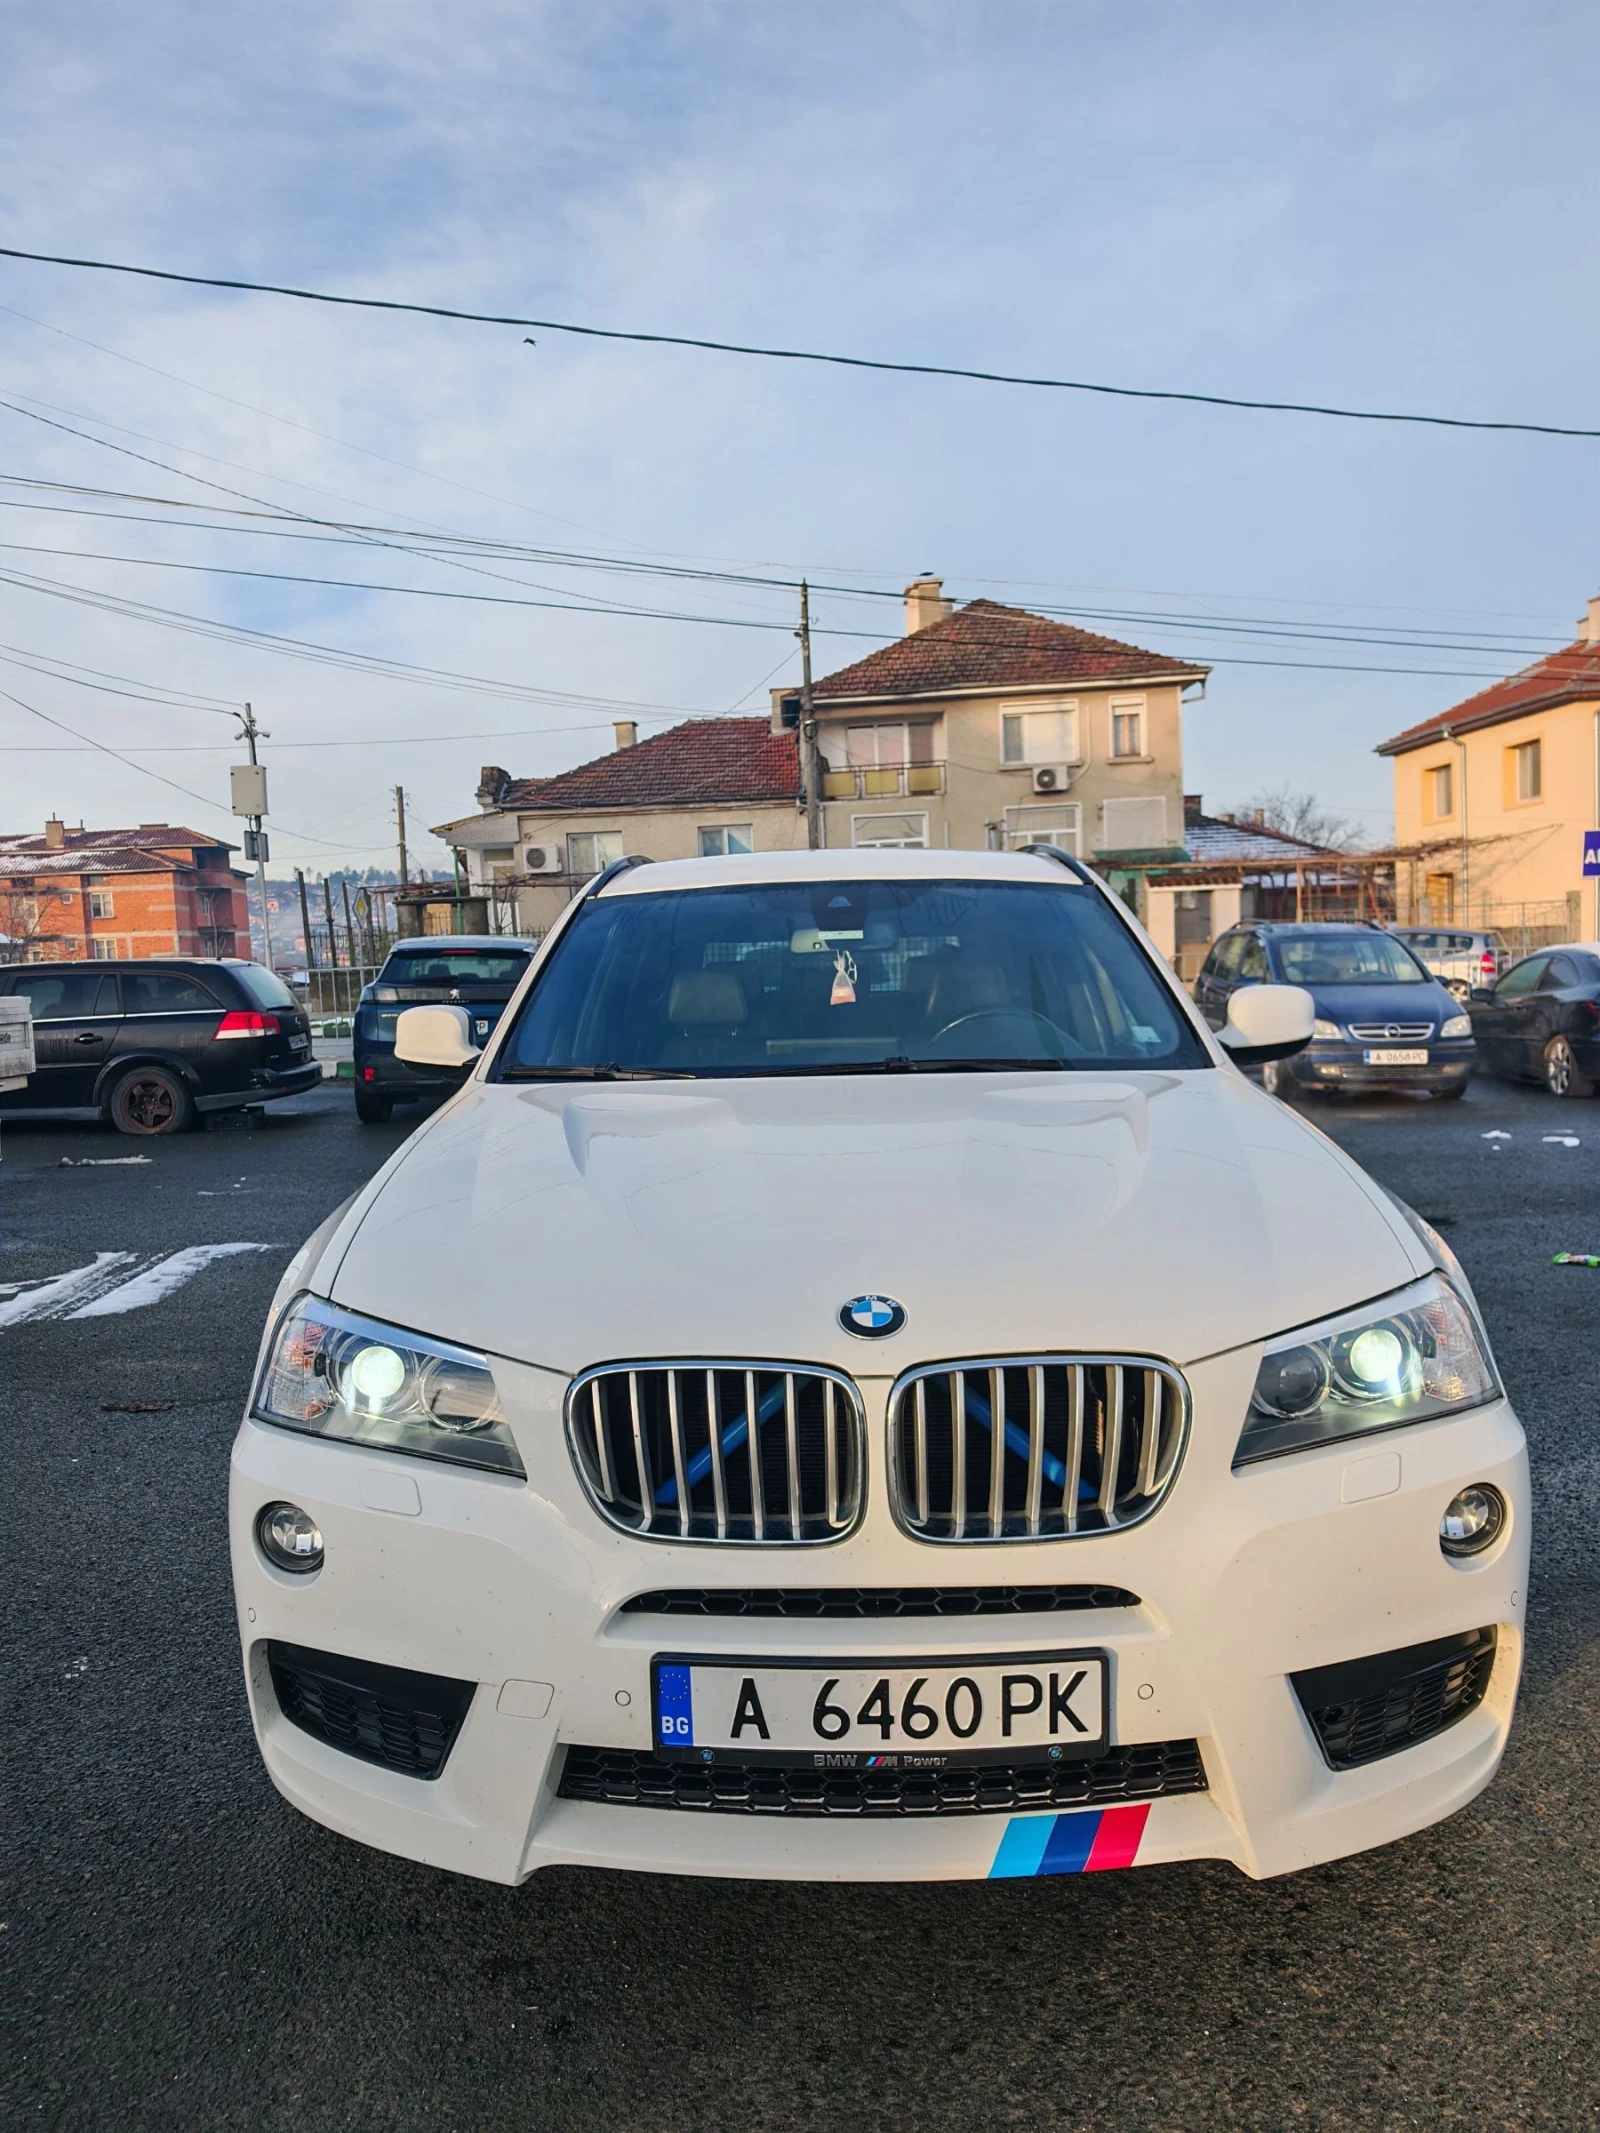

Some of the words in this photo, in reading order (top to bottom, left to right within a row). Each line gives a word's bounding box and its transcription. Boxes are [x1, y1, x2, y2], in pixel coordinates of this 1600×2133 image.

[846, 1295, 899, 1308] BMW
[730, 1677, 771, 1740] A
[811, 1676, 983, 1741] 6460
[1001, 1670, 1089, 1737] PK
[660, 1715, 689, 1735] BG
[813, 1754, 858, 1767] BMW
[903, 1755, 948, 1767] Power
